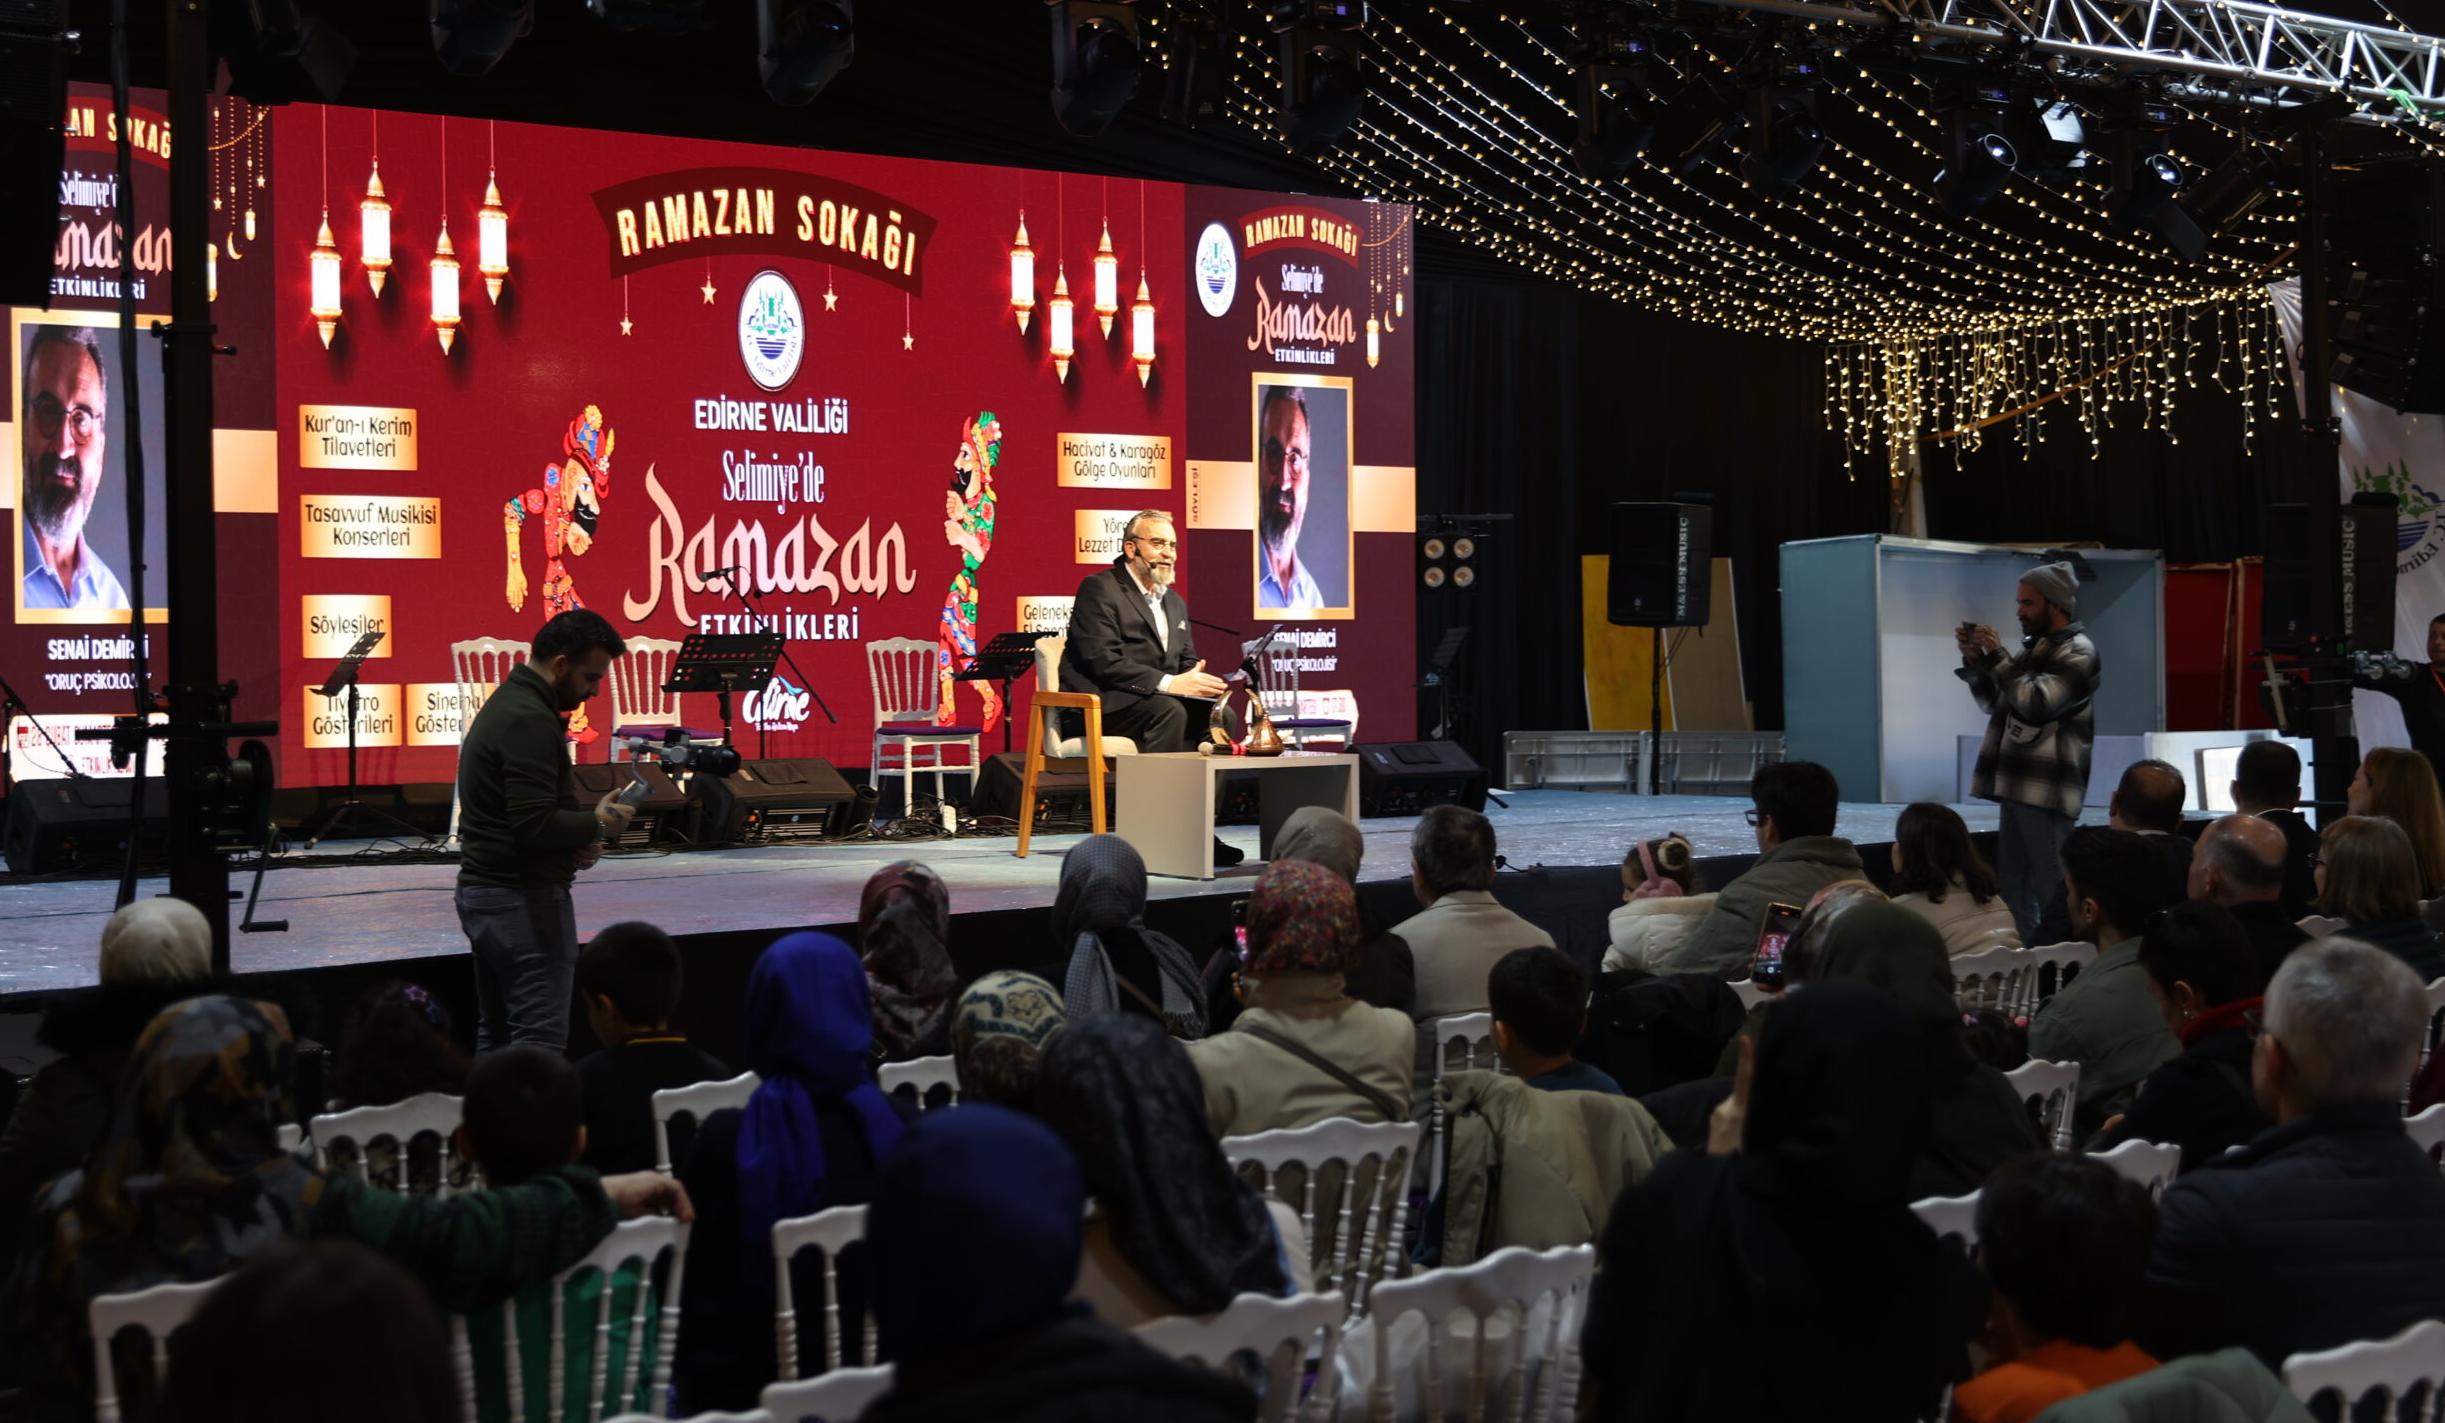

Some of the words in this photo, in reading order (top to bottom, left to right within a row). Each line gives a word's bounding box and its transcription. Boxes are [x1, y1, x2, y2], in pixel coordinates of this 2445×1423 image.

[617, 188, 775, 257] RAMAZAN
[797, 194, 916, 276] SOKAĞI
[1245, 214, 1304, 248] RAMAZAN
[1311, 217, 1357, 257] SOKAĞI
[1247, 275, 1357, 355] Ramazan
[1274, 346, 1335, 365] ETKİNLİKLERİ
[694, 393, 768, 432] EDİRNE
[770, 397, 849, 435] VALİLİĞİ
[369, 416, 413, 438] Kerim
[321, 436, 397, 458] Tilavetleri
[1109, 442, 1117, 458] &
[1120, 443, 1166, 465] Karagöz
[722, 449, 825, 515] Selimiye'de
[1074, 460, 1106, 482] Gölge
[1109, 461, 1156, 481] Oyunları
[304, 502, 375, 525] Tasavvuf
[377, 504, 437, 526] Musikisi
[333, 526, 411, 547] Konserleri
[622, 460, 917, 628] Ramazan
[1078, 536, 1113, 553] Lezzet
[310, 615, 384, 638] Söyleşiler
[1300, 628, 1337, 648] DEMİRCİ
[47, 634, 90, 660] SENAİ
[91, 634, 149, 660] DEMİRİ
[313, 714, 394, 735] Göstrileri
